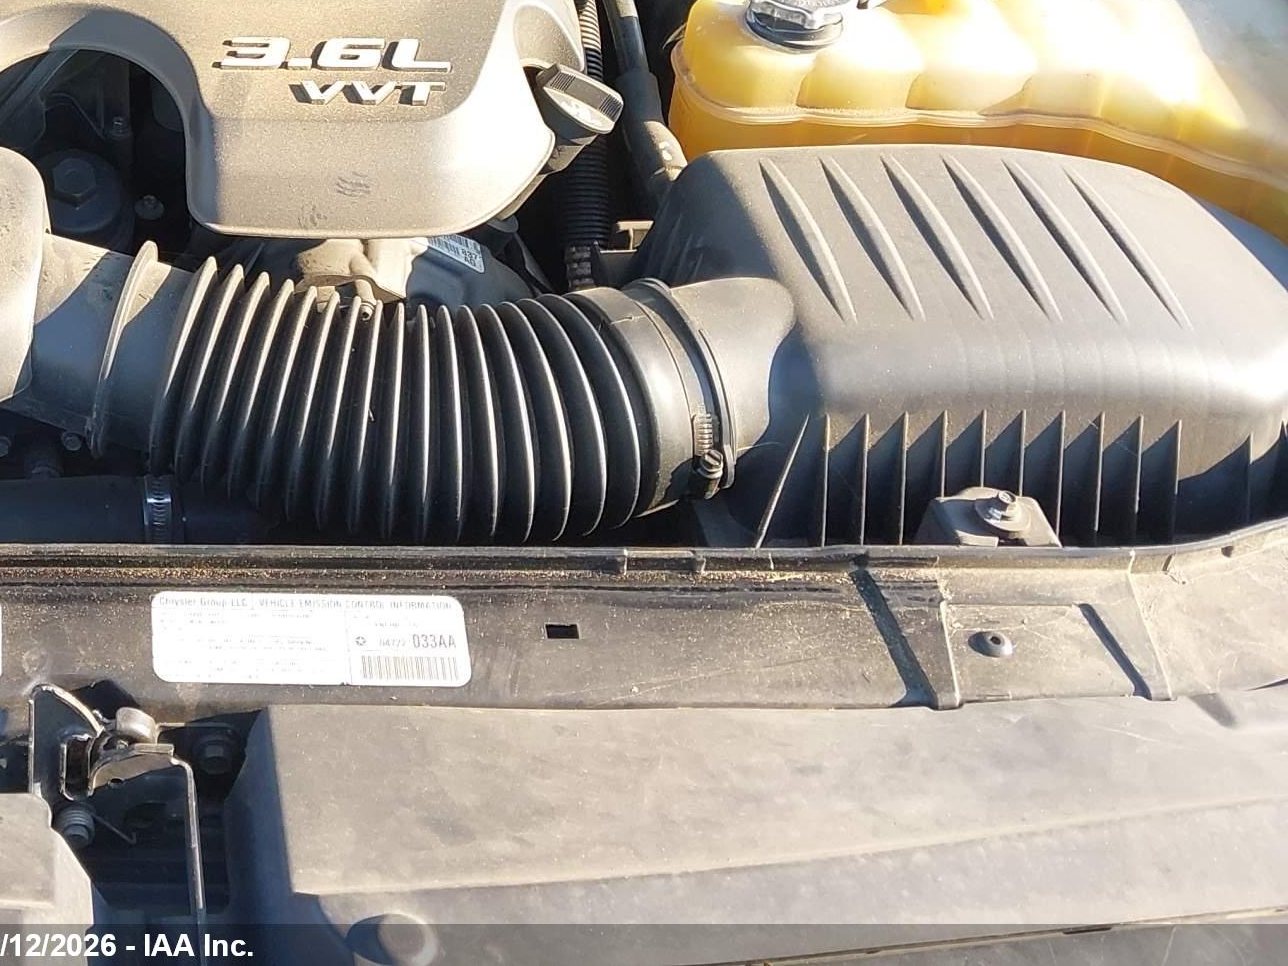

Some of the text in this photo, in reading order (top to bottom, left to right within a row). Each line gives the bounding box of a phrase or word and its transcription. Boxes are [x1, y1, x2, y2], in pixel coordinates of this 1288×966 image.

[213, 37, 452, 72] 3.6L
[289, 80, 446, 106] VVT
[159, 596, 452, 610] Chrysler Group LLC VEHICLE EMISSION CONTROL INFORMATION
[412, 634, 456, 649] 033AA
